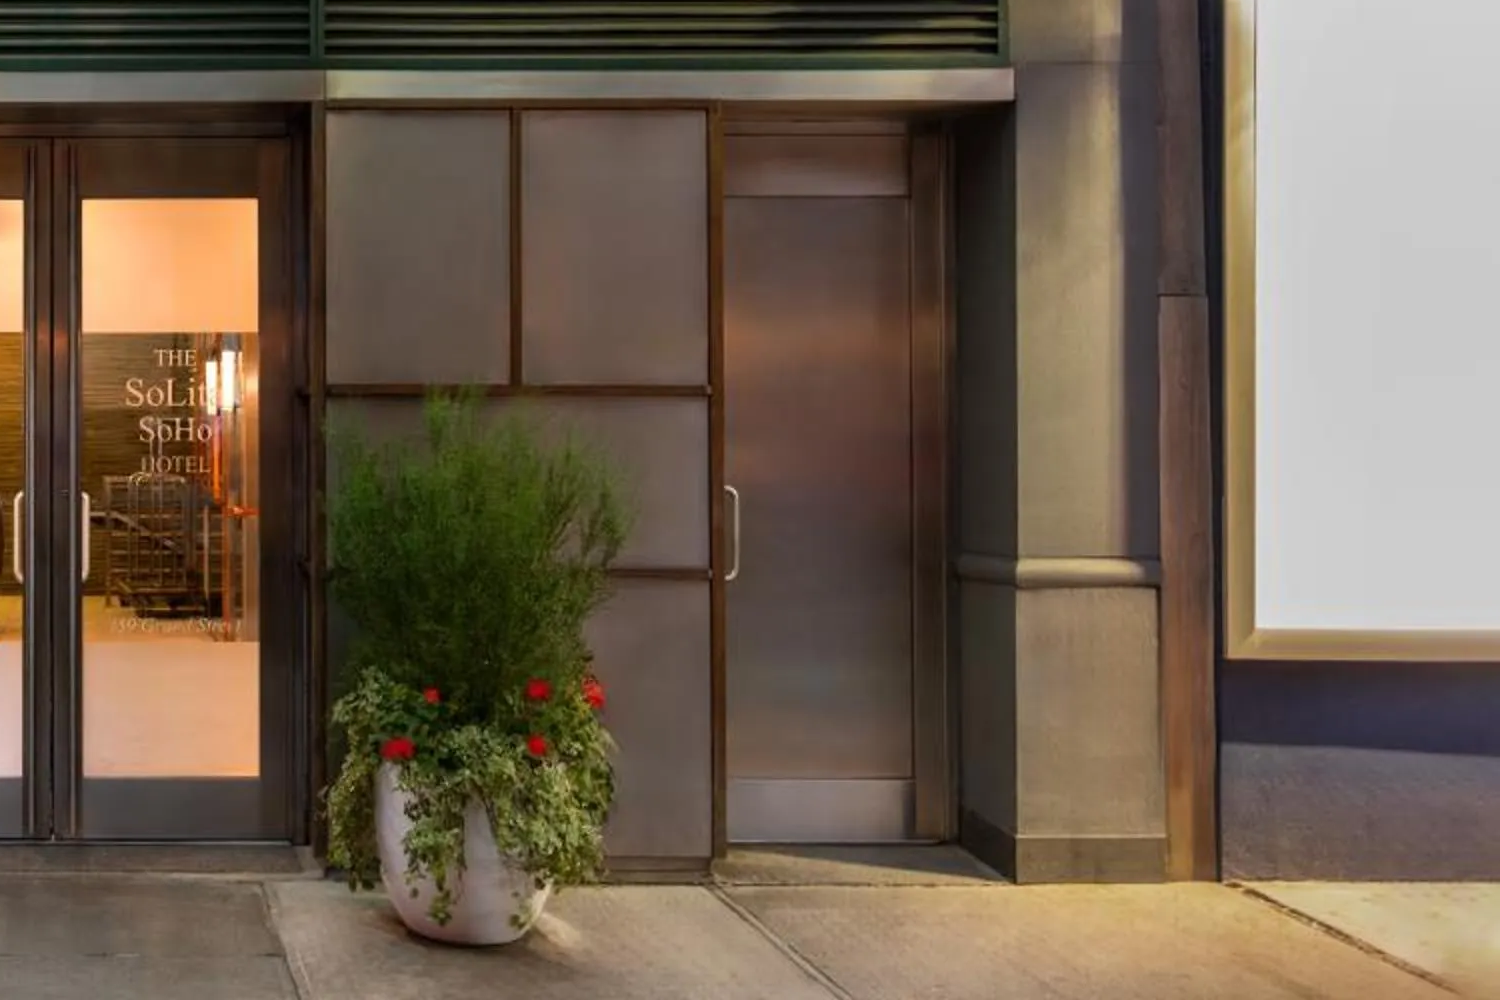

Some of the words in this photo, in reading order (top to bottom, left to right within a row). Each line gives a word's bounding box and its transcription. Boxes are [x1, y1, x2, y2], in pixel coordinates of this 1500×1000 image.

[154, 349, 197, 367] THE
[125, 377, 222, 407] SoLit
[139, 415, 213, 441] SoHo
[141, 455, 212, 473] HOTEL
